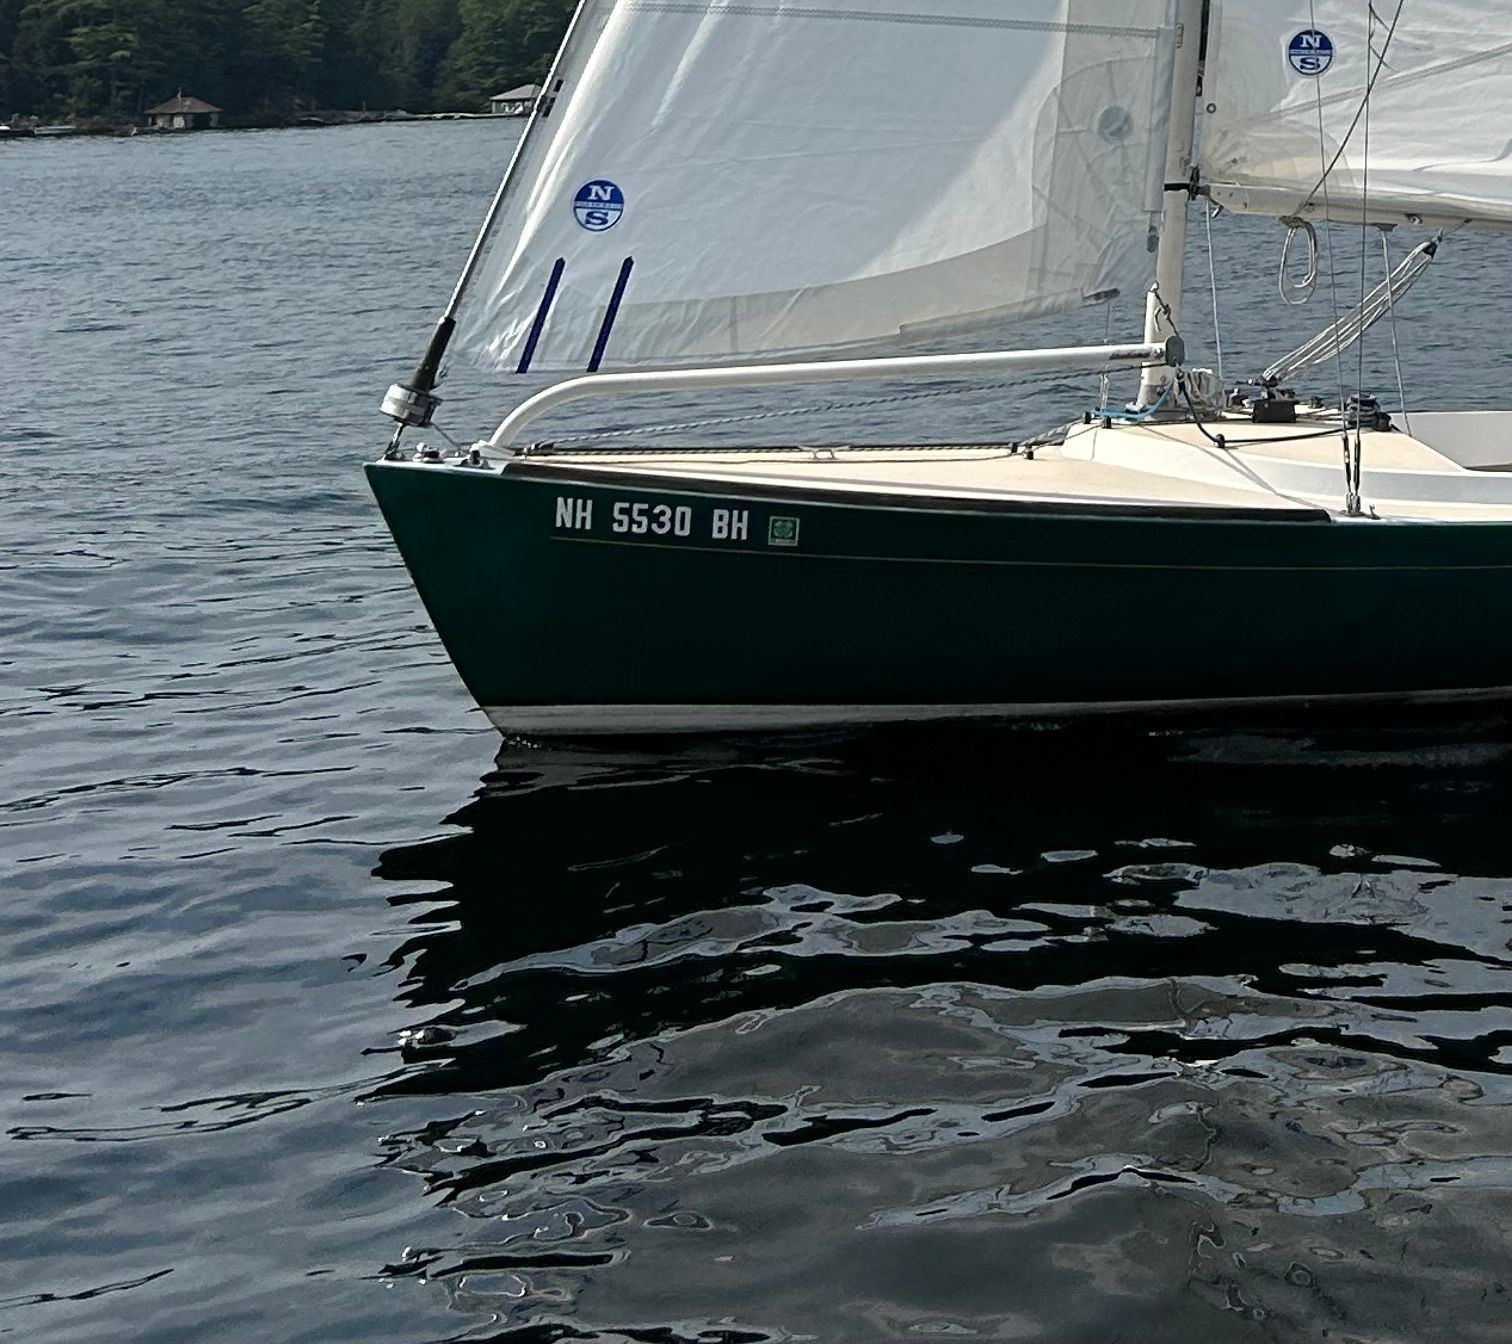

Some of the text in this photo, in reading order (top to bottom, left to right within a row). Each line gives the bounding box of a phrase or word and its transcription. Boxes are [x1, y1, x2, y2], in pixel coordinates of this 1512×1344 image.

[1300, 34, 1322, 48] N
[1300, 57, 1321, 70] S
[587, 185, 615, 200] N
[585, 211, 609, 225] S
[555, 496, 749, 541] NH 5530 BH
